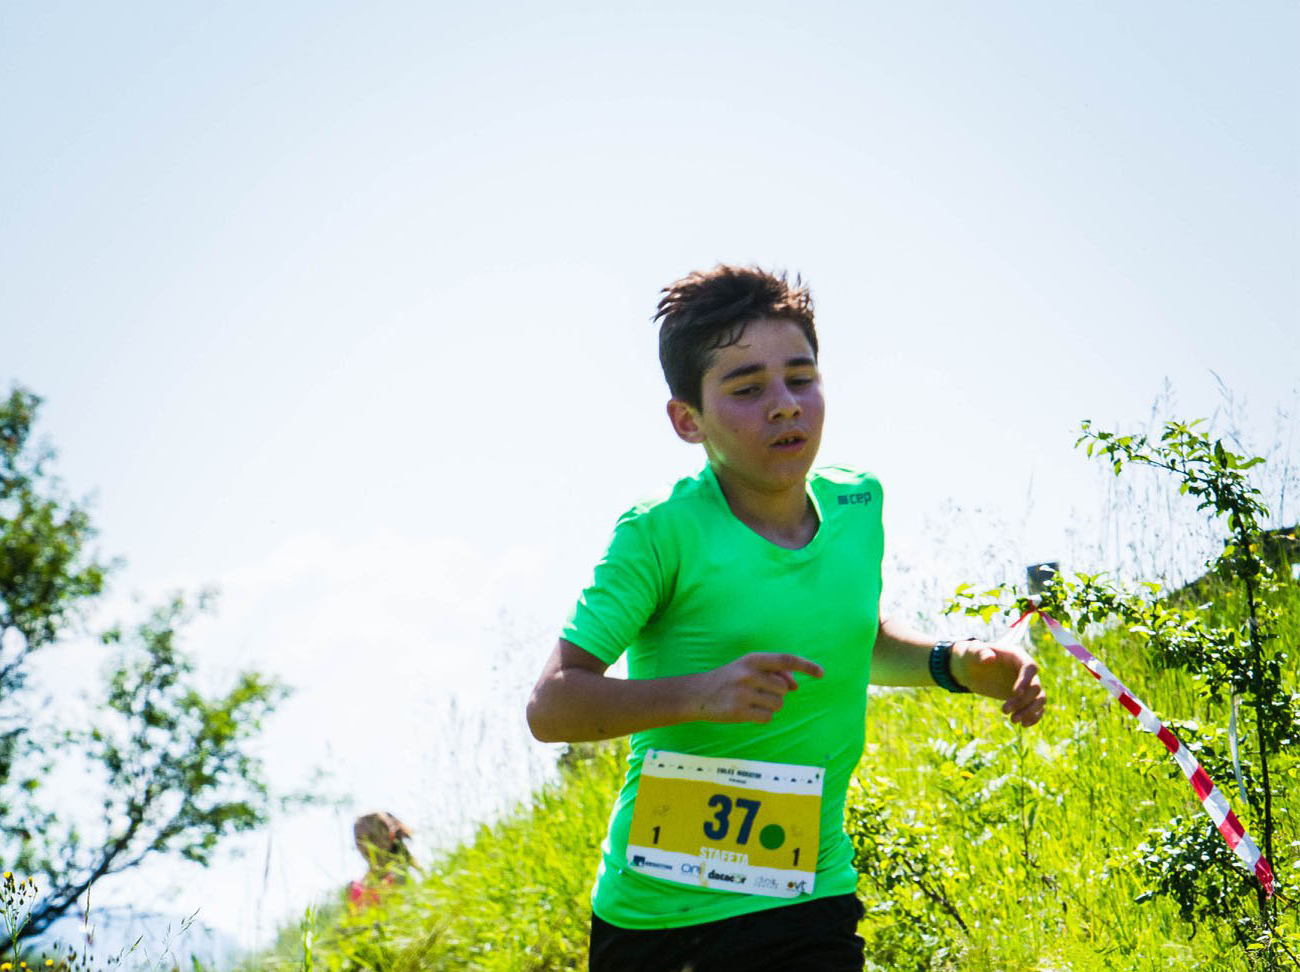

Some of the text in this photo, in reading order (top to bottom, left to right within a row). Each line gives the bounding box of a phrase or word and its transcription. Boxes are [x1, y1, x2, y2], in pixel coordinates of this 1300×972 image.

[703, 794, 761, 845] 37
[652, 826, 661, 845] 1
[792, 848, 801, 866] 1
